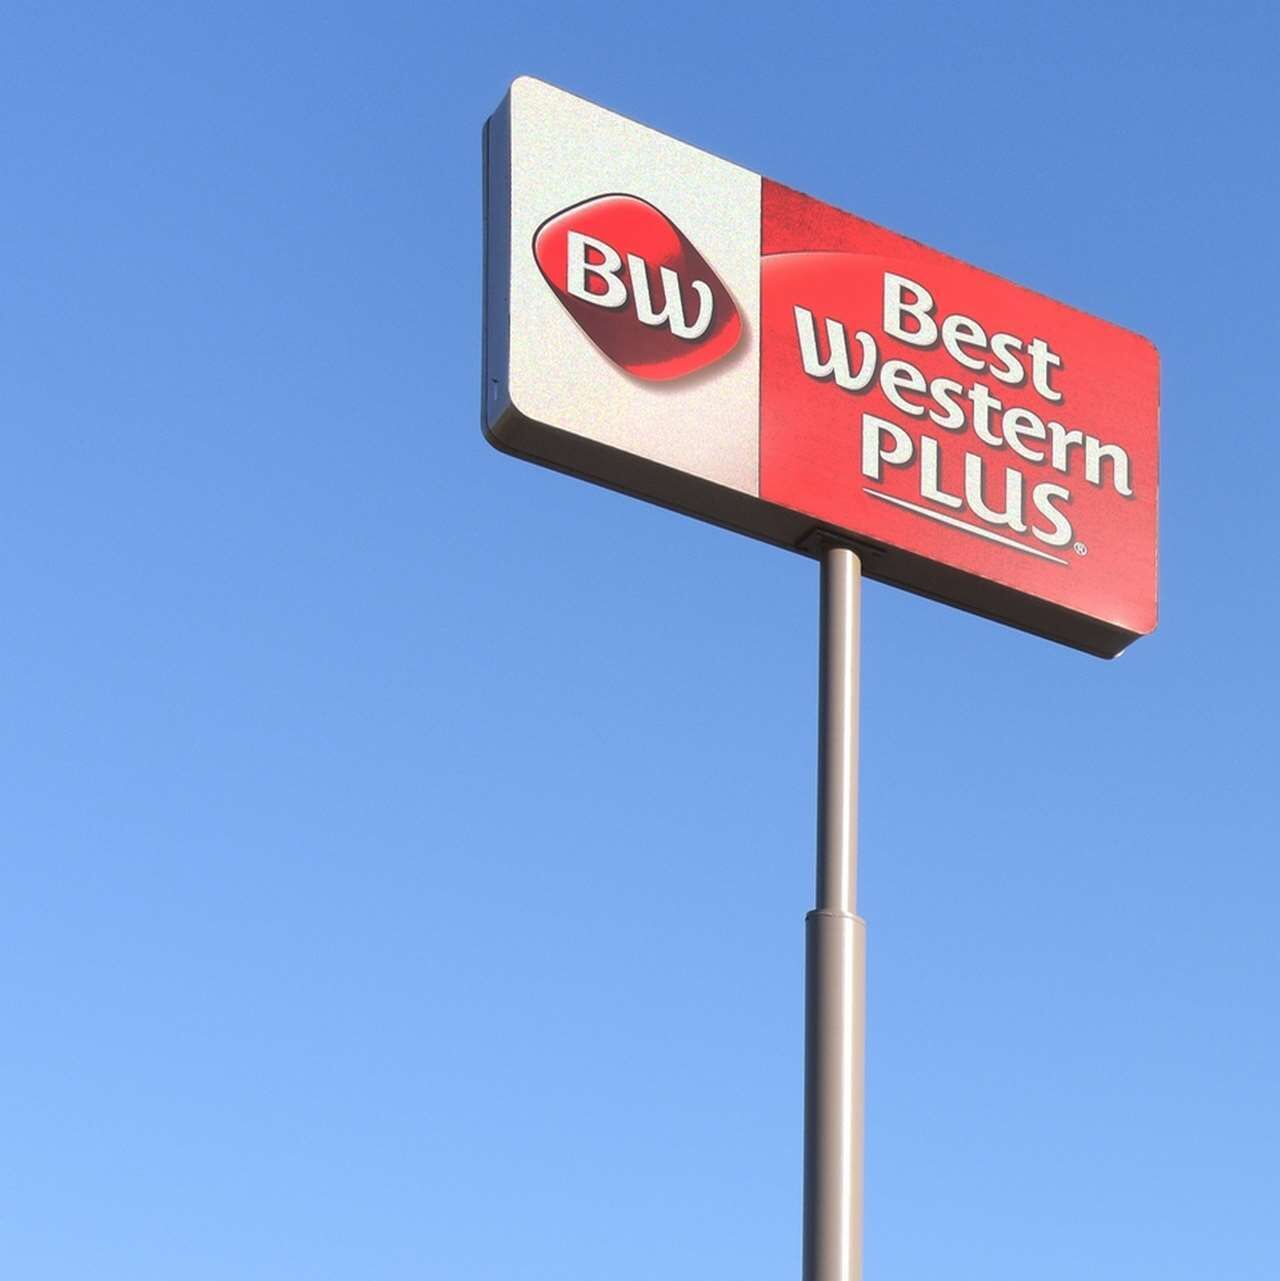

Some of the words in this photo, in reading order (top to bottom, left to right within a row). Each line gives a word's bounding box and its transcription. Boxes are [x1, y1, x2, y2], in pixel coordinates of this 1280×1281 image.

[566, 230, 714, 340] BW
[882, 272, 1062, 401] Best
[793, 305, 1133, 496] Western
